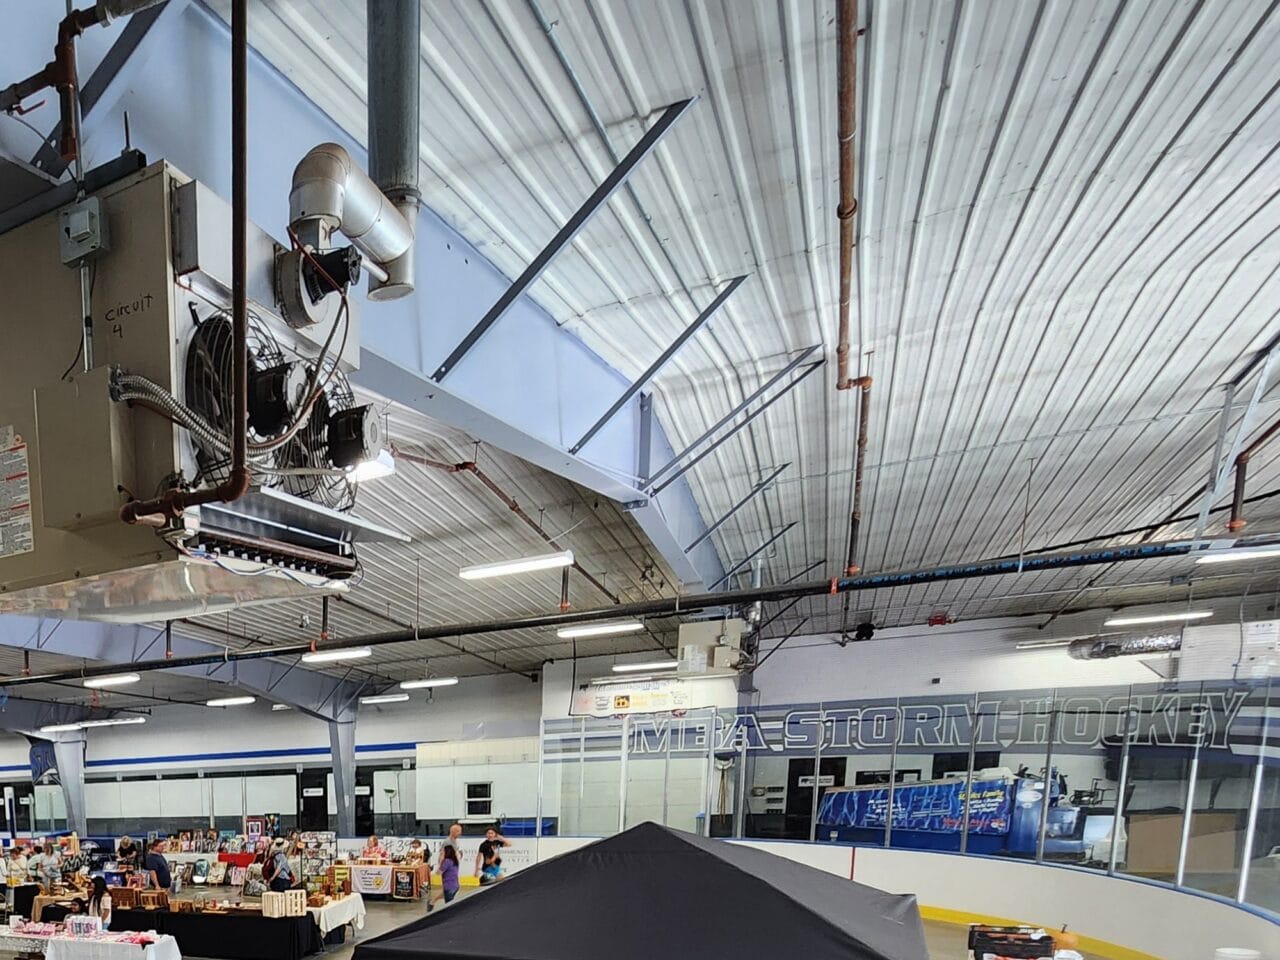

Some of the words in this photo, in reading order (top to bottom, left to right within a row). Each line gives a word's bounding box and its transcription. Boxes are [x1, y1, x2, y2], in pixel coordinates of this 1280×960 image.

[112, 324, 123, 339] 4
[631, 713, 768, 753] MBA
[782, 700, 1002, 751] STORM
[1018, 692, 1249, 749] HOCKEY
